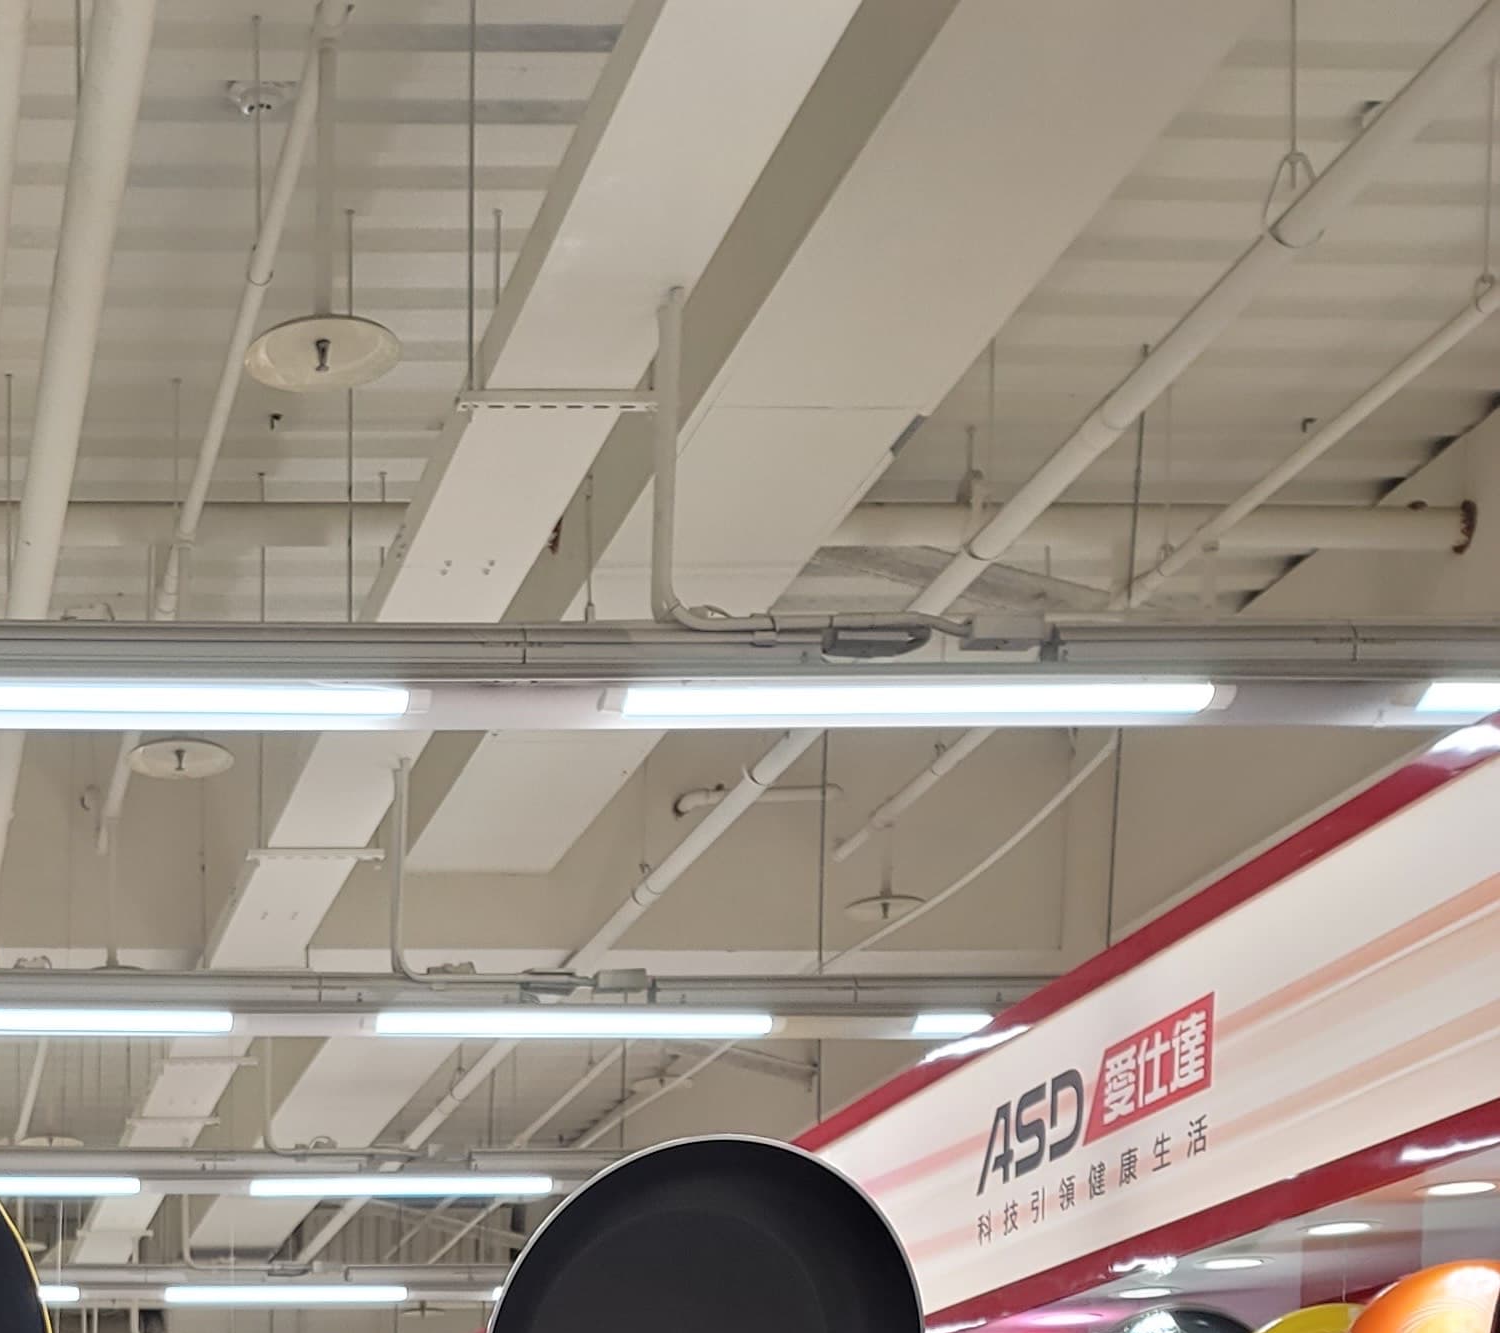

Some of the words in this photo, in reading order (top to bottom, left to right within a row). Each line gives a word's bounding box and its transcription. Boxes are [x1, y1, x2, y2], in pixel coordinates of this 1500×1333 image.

[976, 1068, 1084, 1196] ASD
[1102, 1010, 1207, 1125] 愛仕達
[977, 1113, 1208, 1247] 科技引領健康生活
